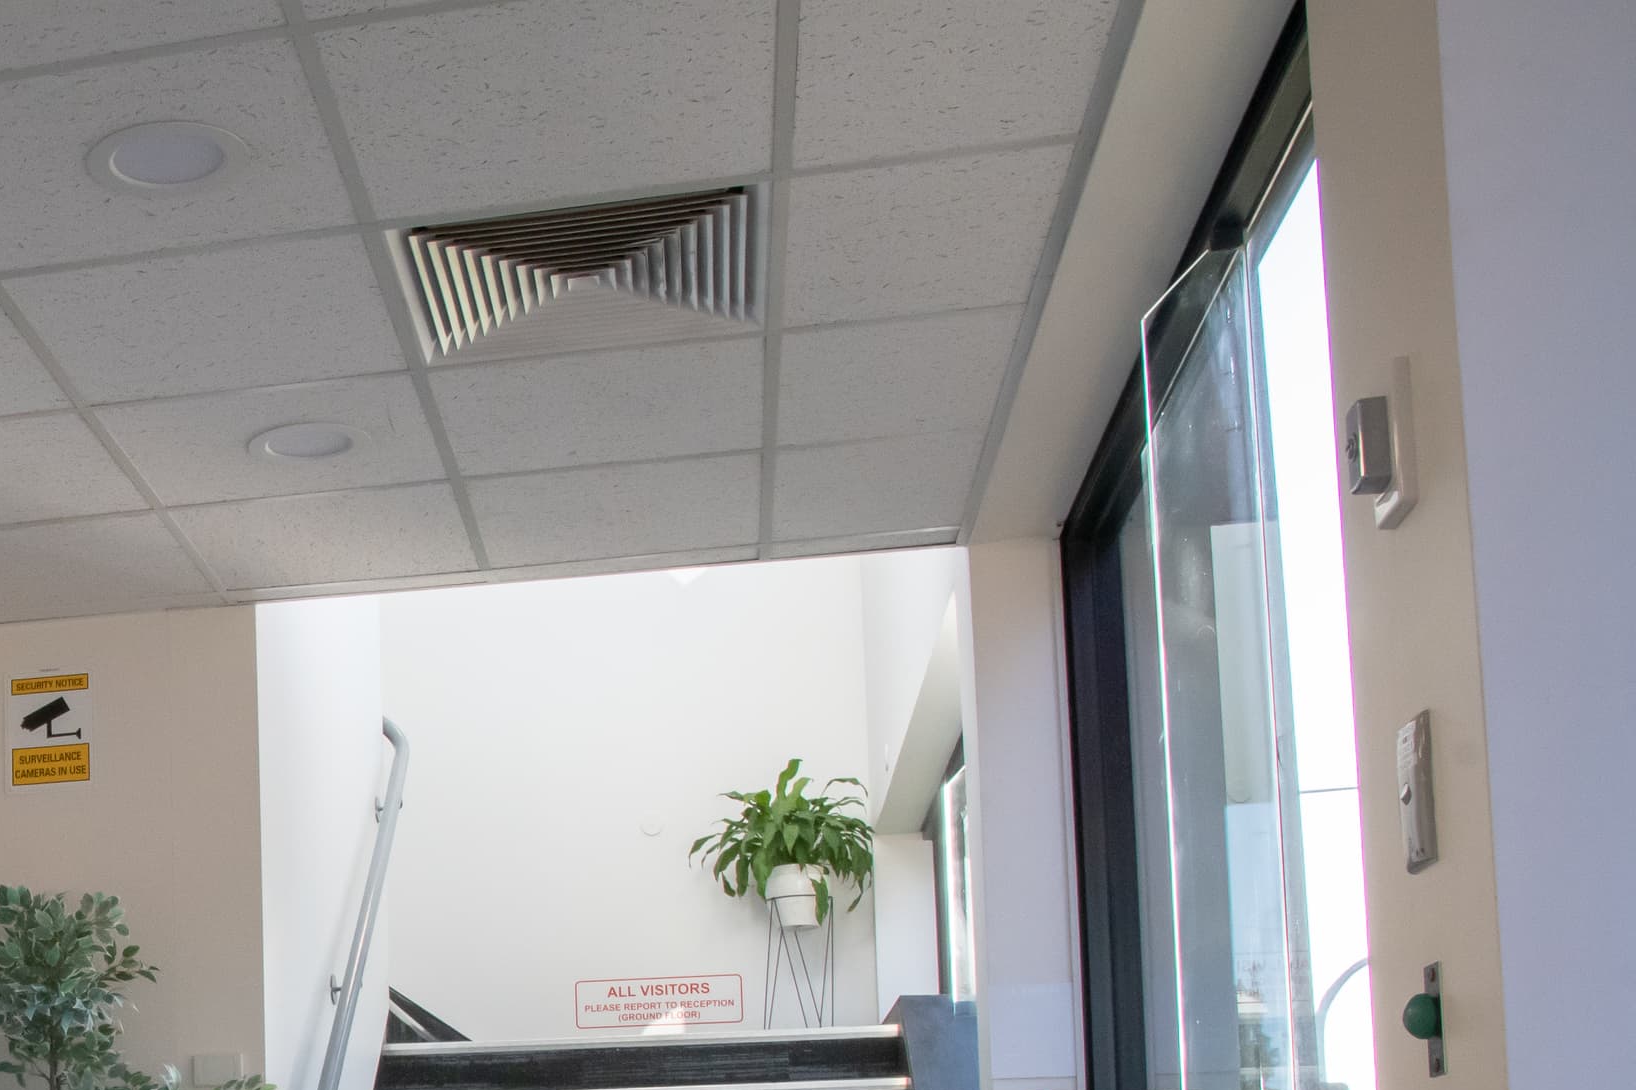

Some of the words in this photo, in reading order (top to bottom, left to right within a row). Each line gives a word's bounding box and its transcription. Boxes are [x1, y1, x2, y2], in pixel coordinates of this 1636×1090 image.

[16, 680, 54, 692] SECURITY
[55, 678, 85, 689] NOTICE
[19, 751, 82, 765] SURVEILLANCE
[15, 767, 56, 779] CAMERAS
[58, 766, 68, 776] IN
[69, 765, 87, 775] USE
[607, 986, 636, 998] ALL
[640, 982, 710, 997] VISITORS
[584, 1002, 621, 1013] PLEASE
[624, 1001, 662, 1011] REPORT
[665, 1000, 678, 1010] TO
[680, 999, 735, 1009] RECEPTION
[618, 1012, 662, 1023] (GROUND
